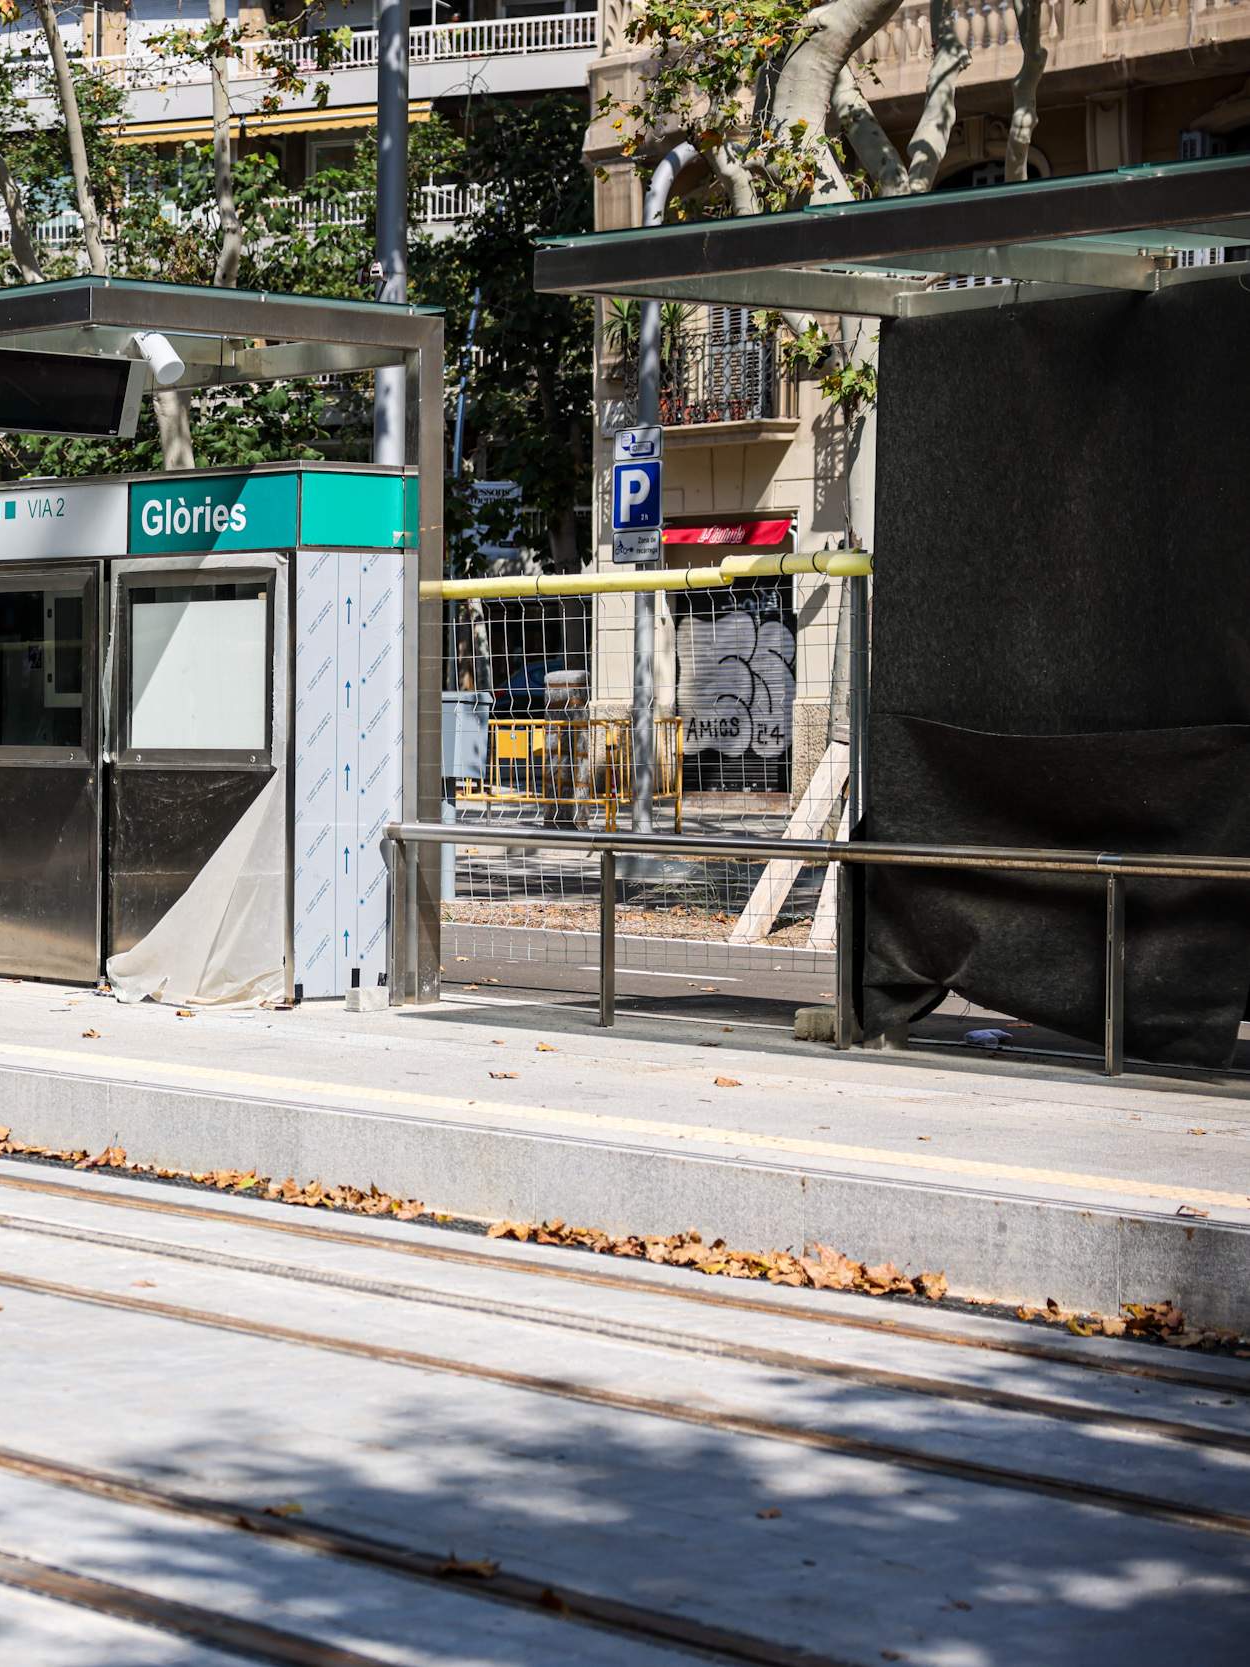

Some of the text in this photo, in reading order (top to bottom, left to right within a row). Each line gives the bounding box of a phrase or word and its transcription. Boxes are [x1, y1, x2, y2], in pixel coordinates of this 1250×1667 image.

[27, 497, 65, 519] VIA 2
[141, 496, 247, 537] Glòries
[620, 469, 651, 523] P
